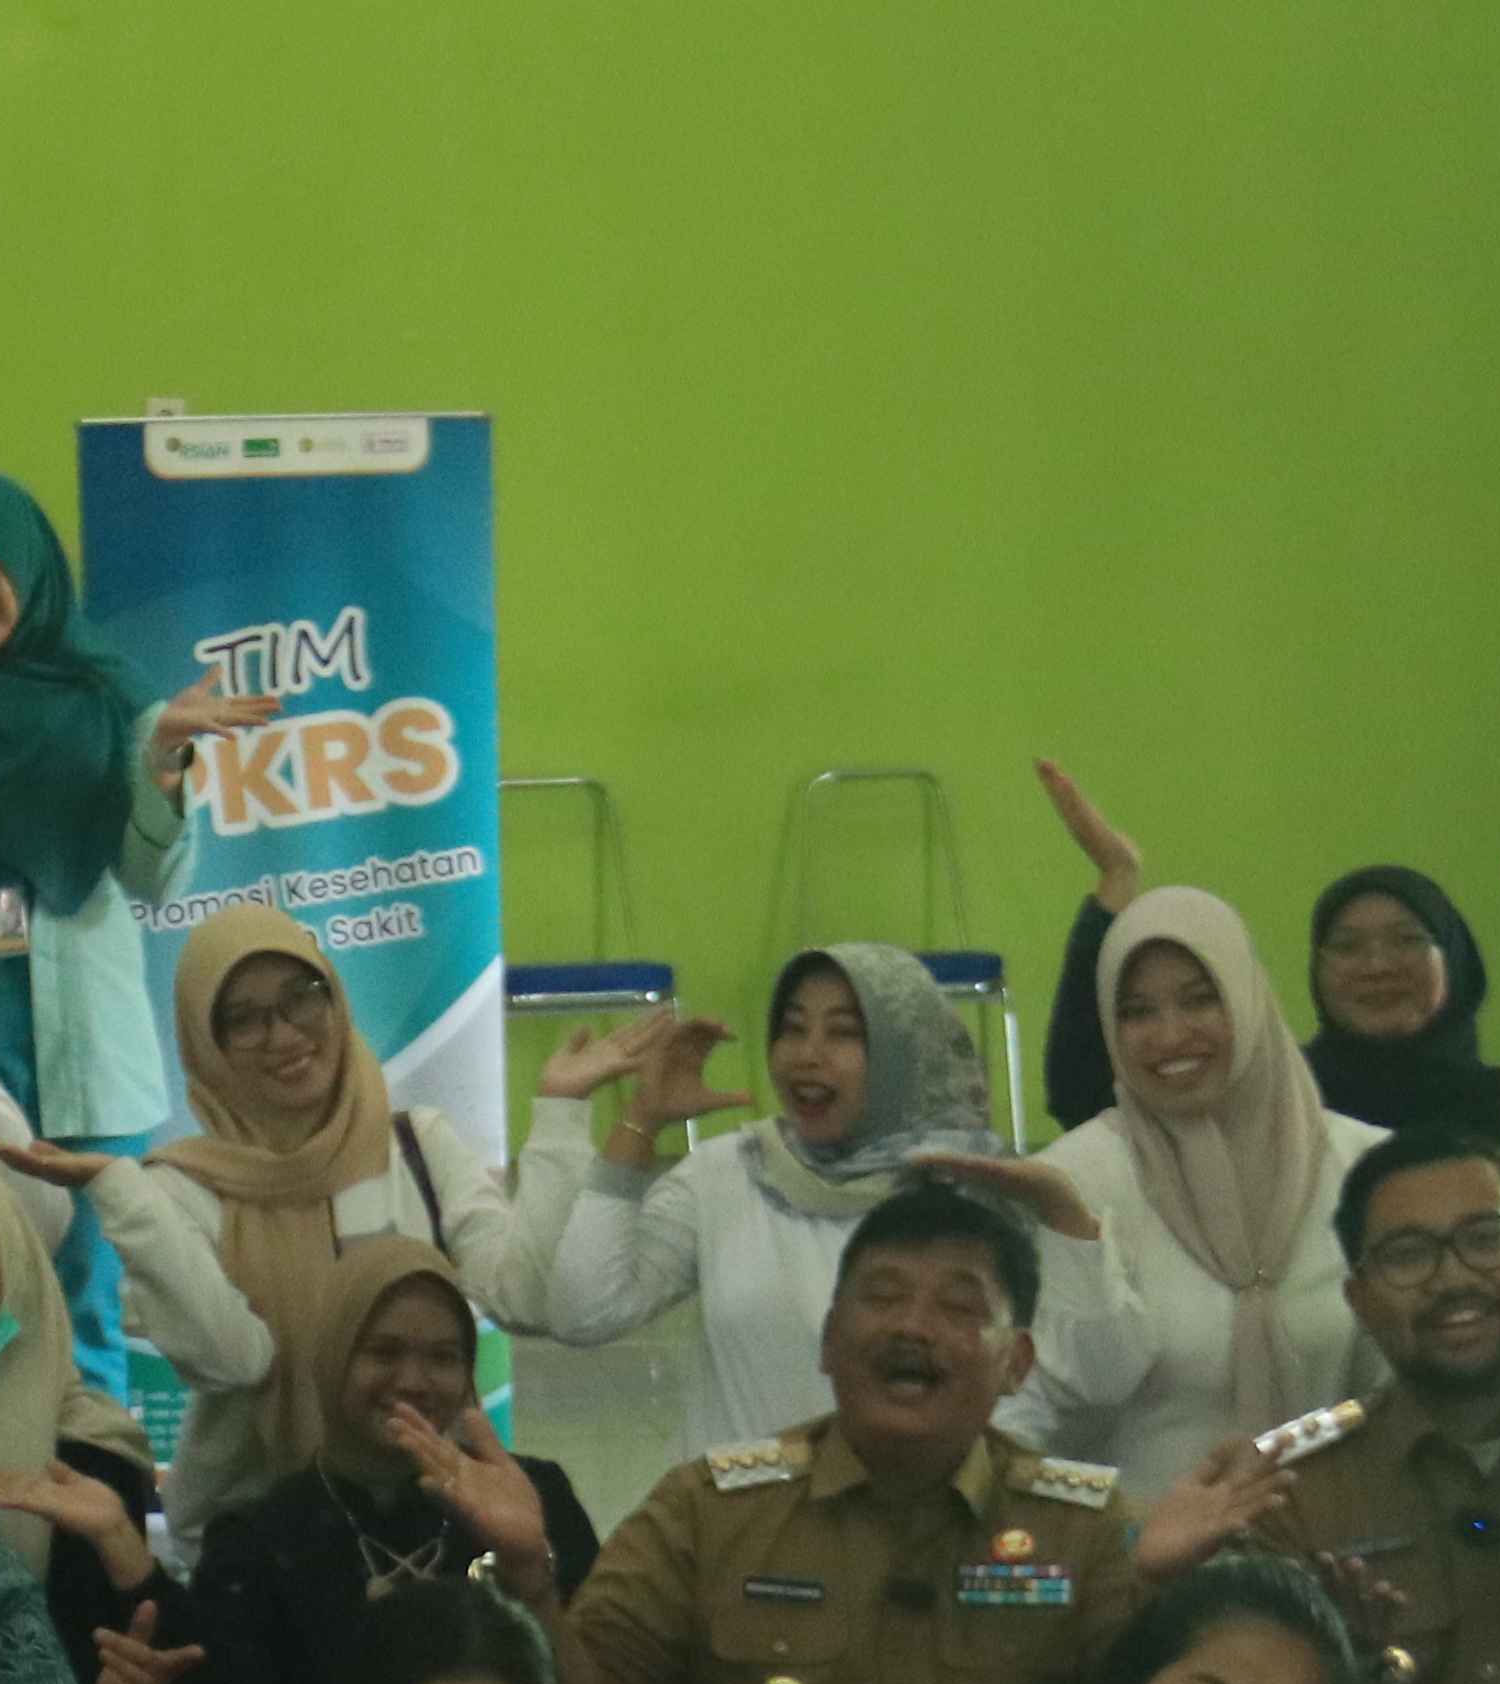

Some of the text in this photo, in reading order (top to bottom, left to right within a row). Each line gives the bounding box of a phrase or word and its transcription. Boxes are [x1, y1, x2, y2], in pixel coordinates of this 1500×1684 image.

[204, 614, 363, 694] TIM
[284, 849, 479, 903] Kesehatan
[331, 906, 419, 945] Sakit
